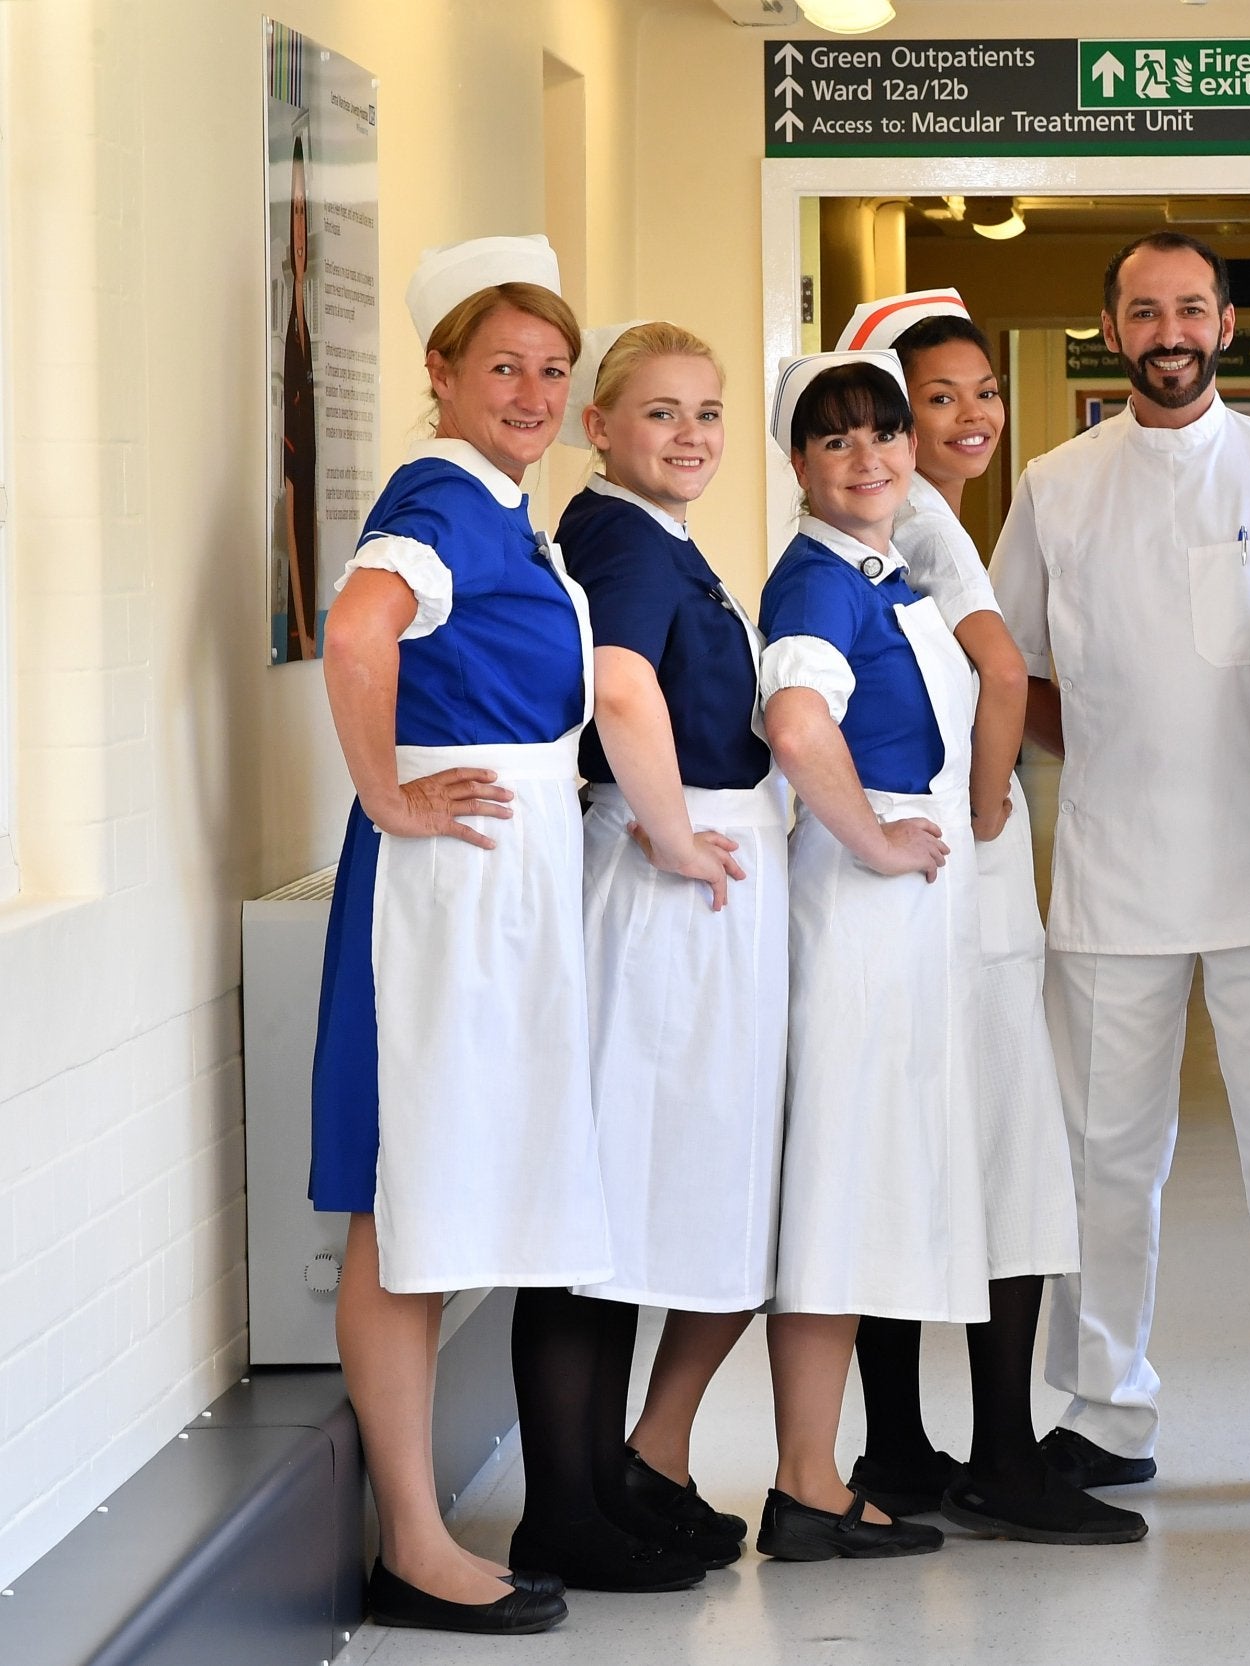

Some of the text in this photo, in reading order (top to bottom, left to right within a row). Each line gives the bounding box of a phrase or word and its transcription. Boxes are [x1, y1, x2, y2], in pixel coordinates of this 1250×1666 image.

[811, 45, 1035, 72] Green Outpatients
[811, 77, 969, 101] Ward 12a/12b
[811, 109, 1194, 134] Access to: Macular Treatment Unit
